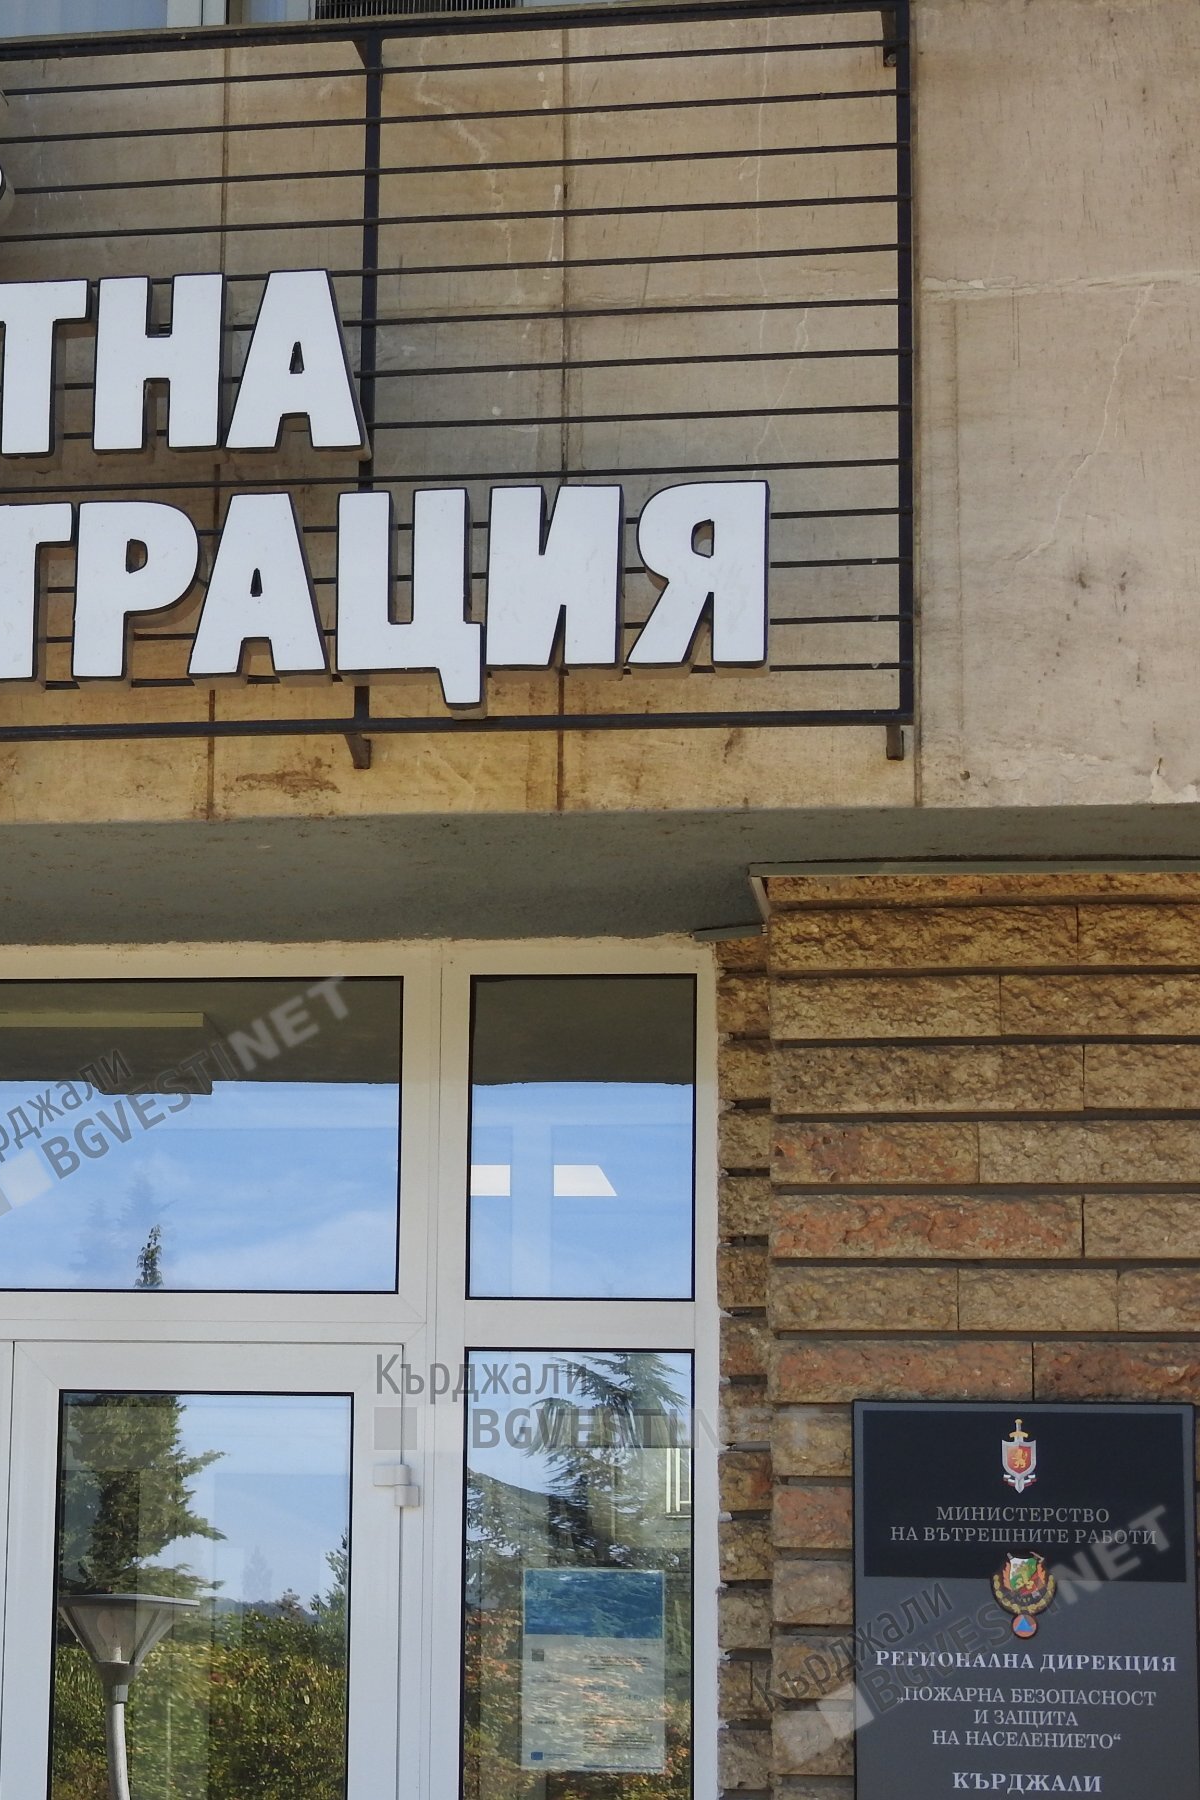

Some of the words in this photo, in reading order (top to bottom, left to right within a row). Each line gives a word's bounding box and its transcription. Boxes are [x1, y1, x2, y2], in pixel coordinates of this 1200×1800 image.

[935, 1506, 1110, 1524] МИНИСТЕРСТВО
[890, 1526, 918, 1541] НА
[922, 1526, 1070, 1544] ВЪТРЕШНИТЕ
[1074, 1529, 1158, 1546] РАБОТИ
[875, 1650, 1035, 1669] РЕГИОНАЛНА
[1039, 1653, 1177, 1675] ДИРЕКЦИЯ
[896, 1685, 1006, 1704] „ПОЖАРНА
[1009, 1688, 1157, 1707] БЕЗОПАСНОСТ
[973, 1709, 989, 1724] И
[993, 1709, 1079, 1729] ЗАЩИТА
[932, 1730, 960, 1745] НА
[952, 1771, 1102, 1794] КЪРДЖАЛИ
